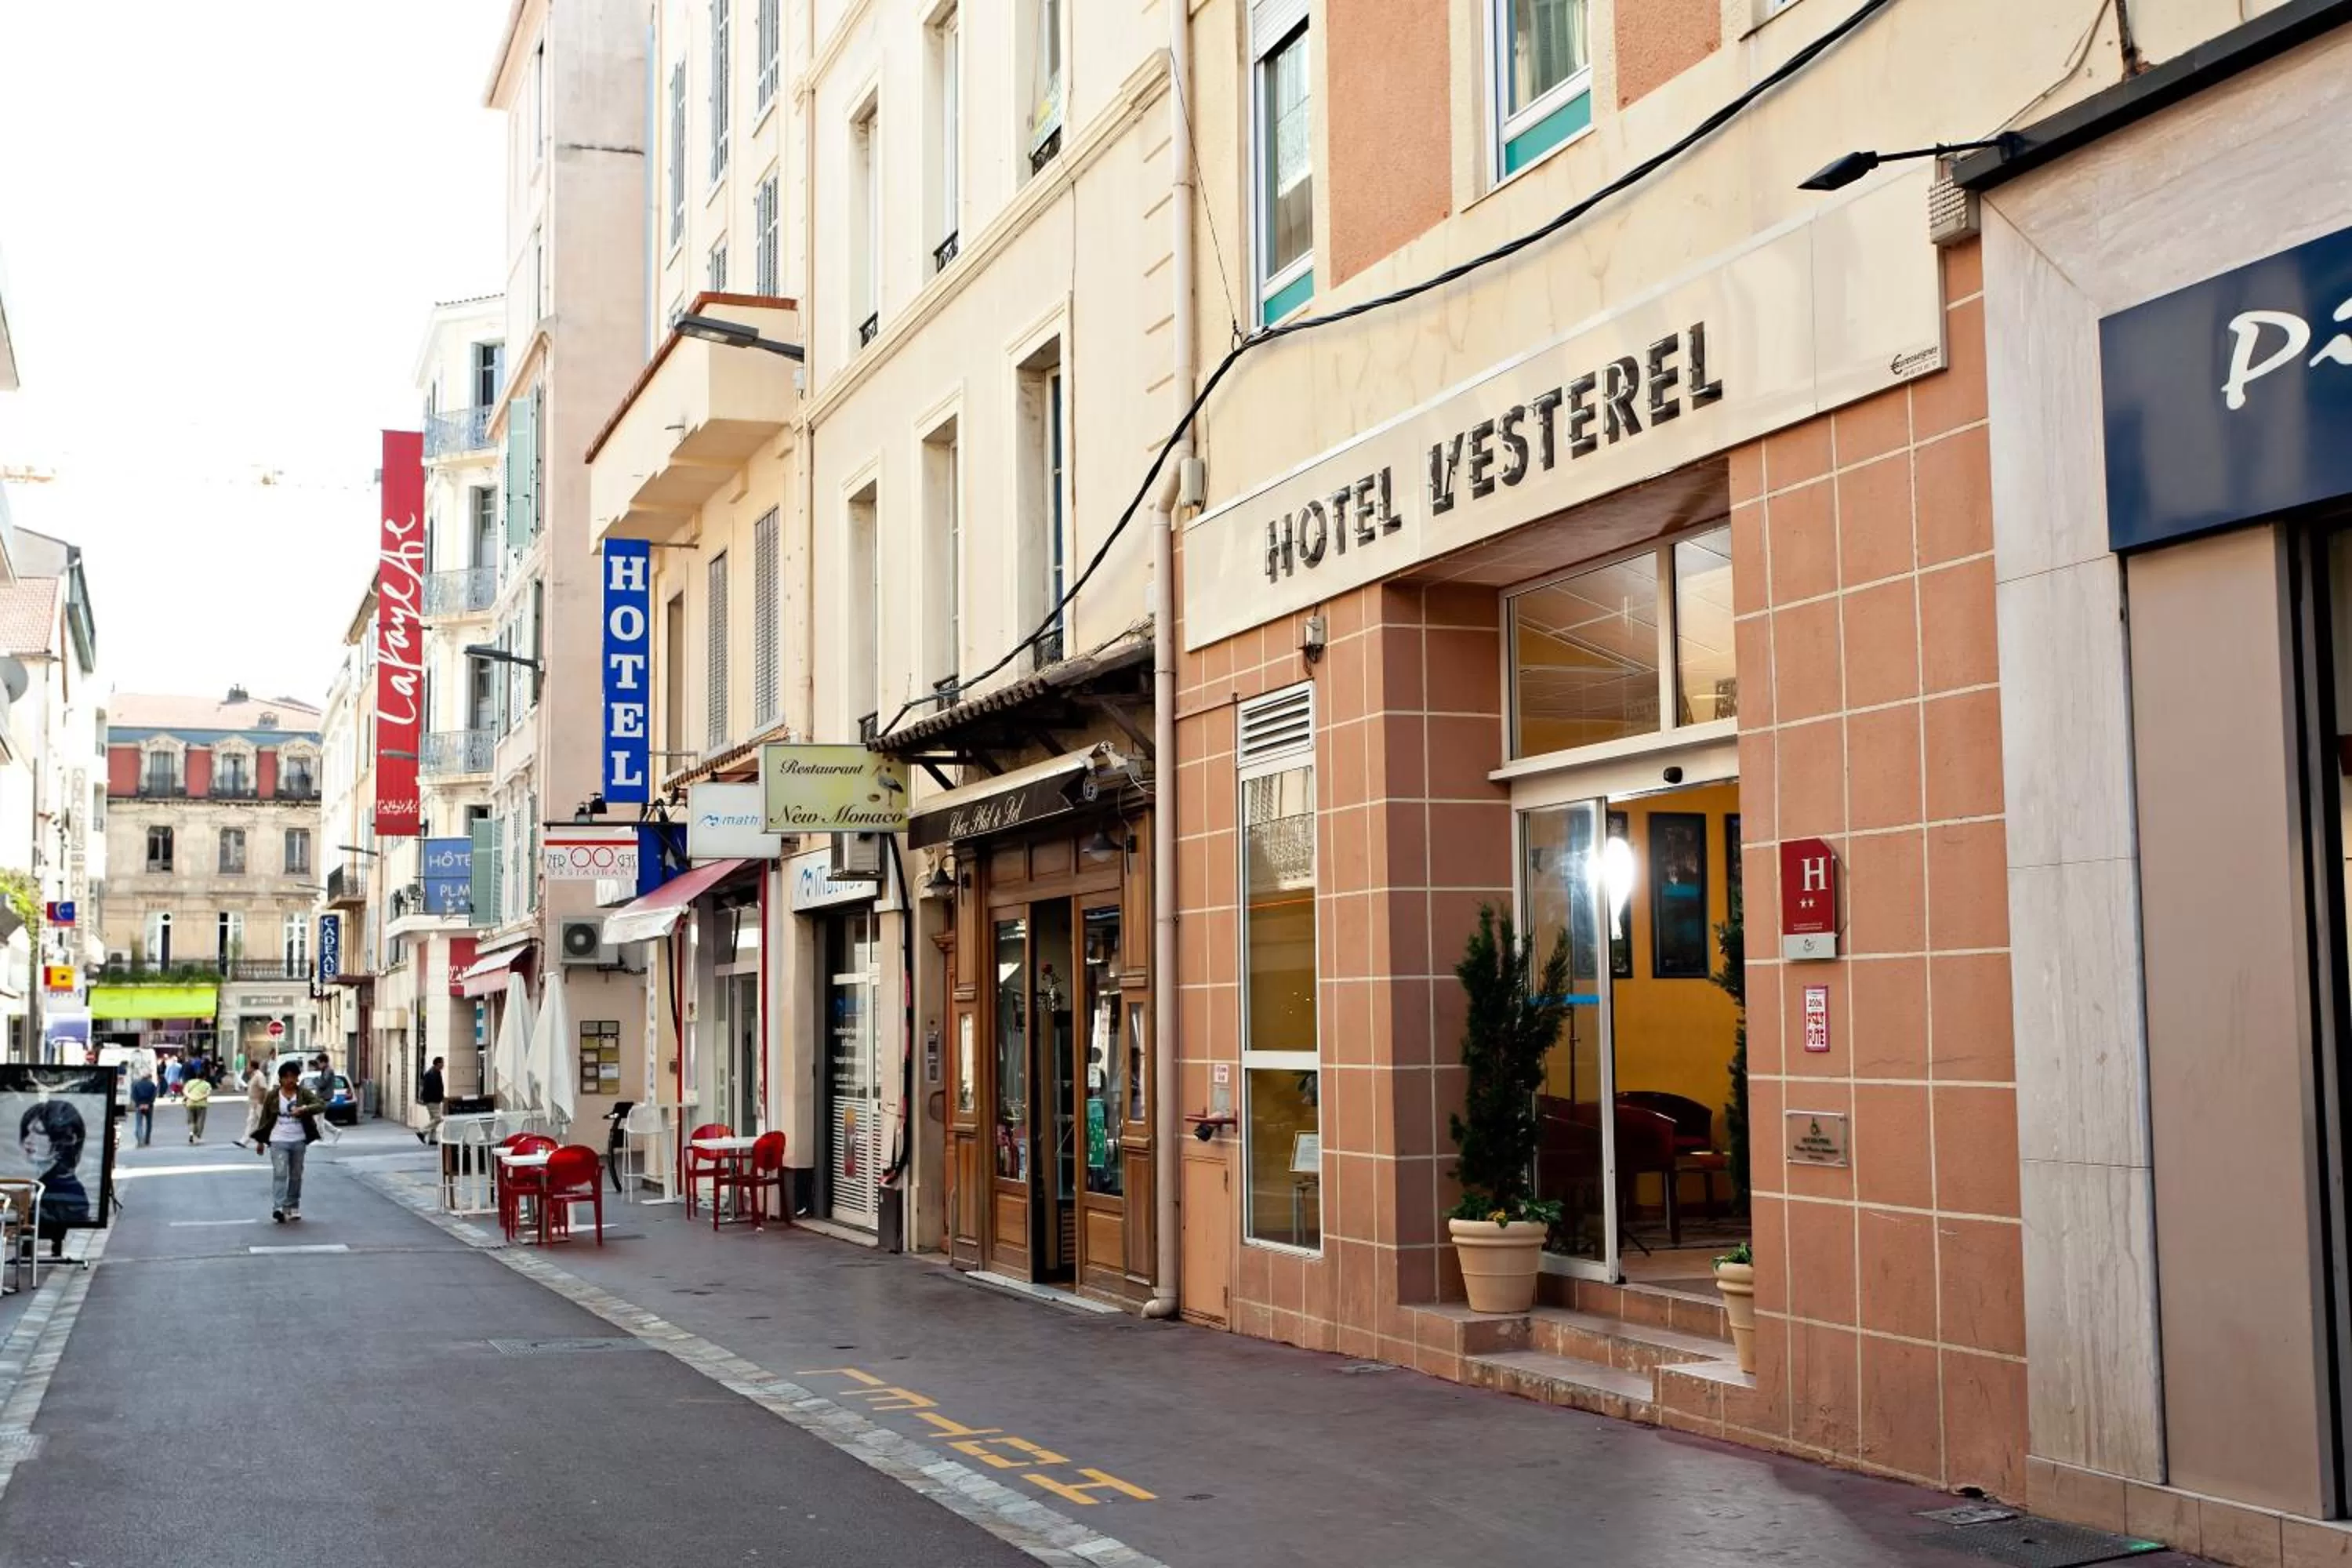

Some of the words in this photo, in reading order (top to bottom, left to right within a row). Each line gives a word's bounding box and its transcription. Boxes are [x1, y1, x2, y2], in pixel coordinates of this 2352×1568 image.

[1265, 466, 1402, 583] HOTEL
[1428, 321, 1722, 517] L'ESTEREL
[609, 555, 647, 787] HOTEL
[780, 758, 865, 776] Restaurant
[720, 814, 761, 826] math
[770, 804, 818, 824] New
[822, 804, 903, 824] Monaco
[429, 851, 471, 869] HÔTE
[1802, 857, 1828, 891] H
[440, 884, 470, 898] PLM
[794, 1367, 1159, 1504] HOTEL
